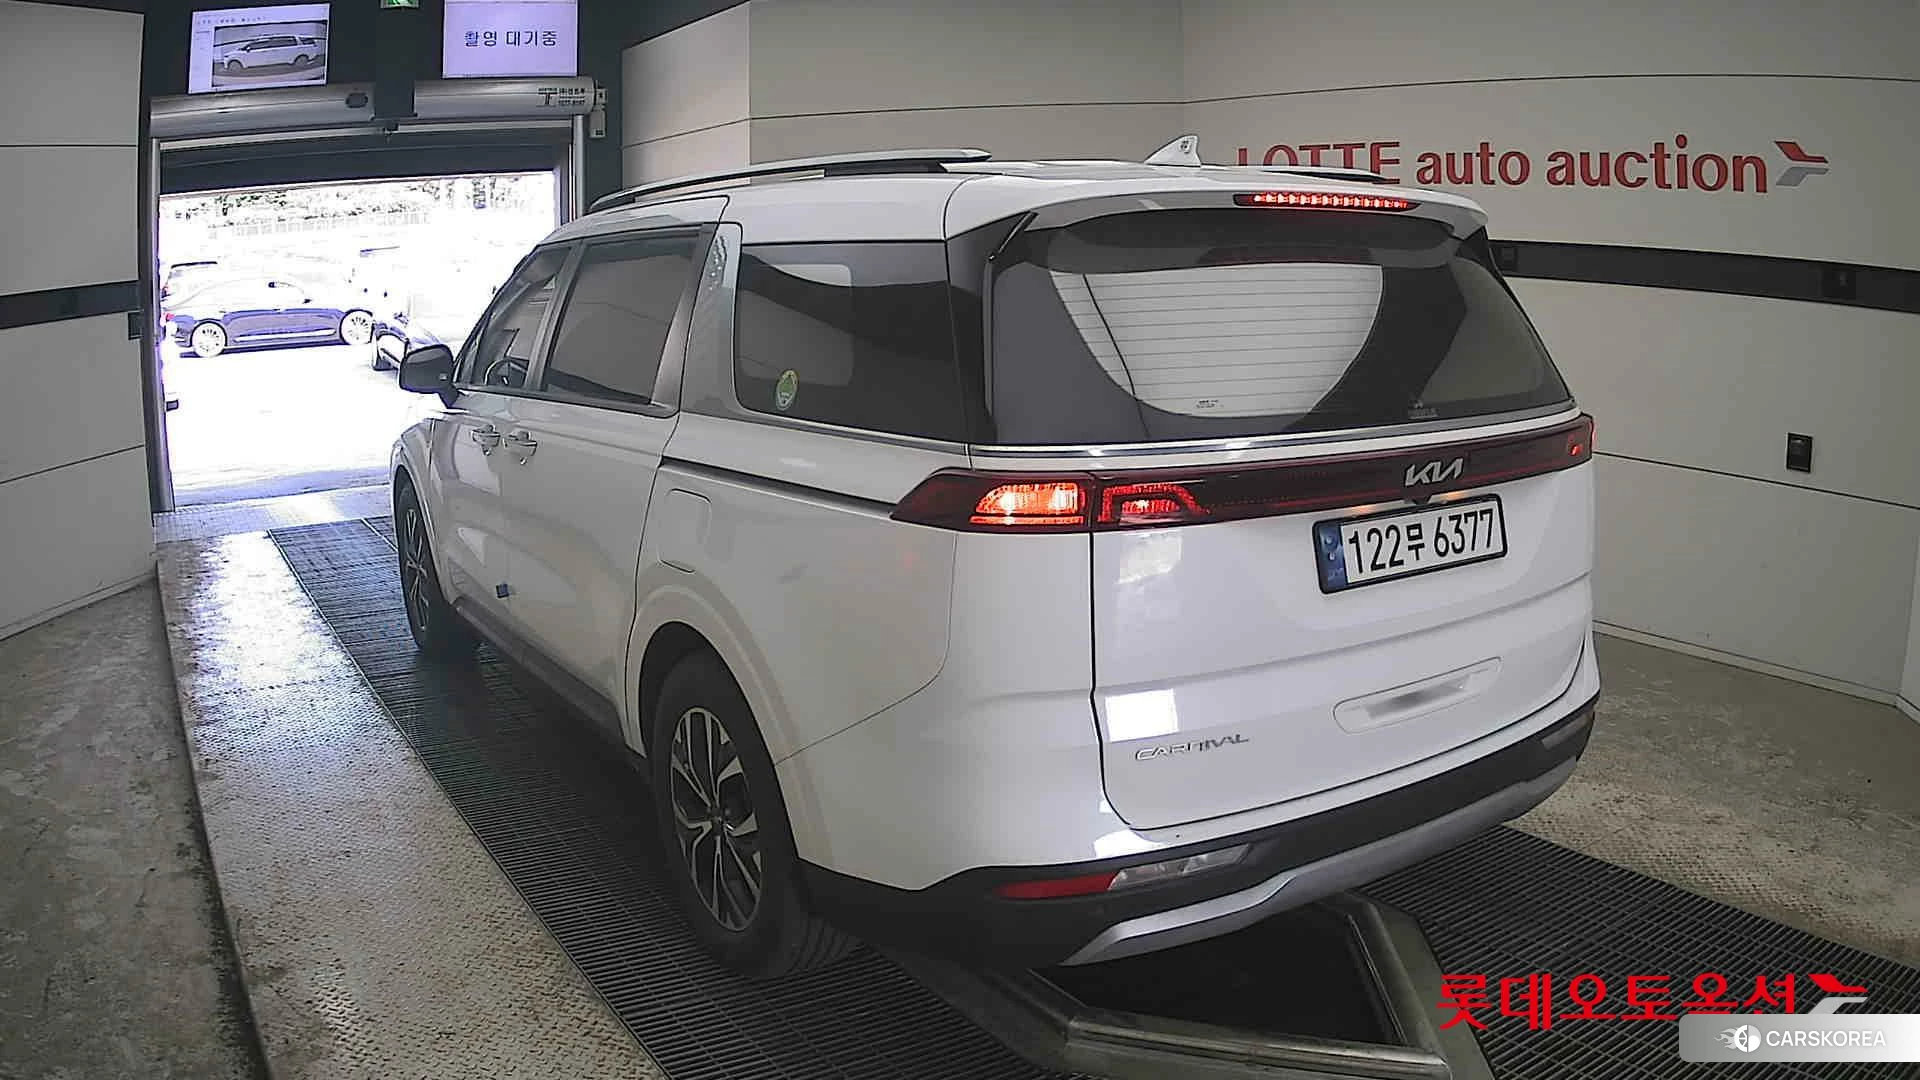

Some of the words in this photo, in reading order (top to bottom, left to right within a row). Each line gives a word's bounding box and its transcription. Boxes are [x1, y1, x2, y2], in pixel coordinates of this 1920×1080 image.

[505, 30, 558, 47] 대기중
[1416, 142, 1530, 186] auto
[1546, 134, 1767, 193] auction
[1434, 508, 1494, 558] 6377
[1135, 734, 1249, 761] CARNIVAL
